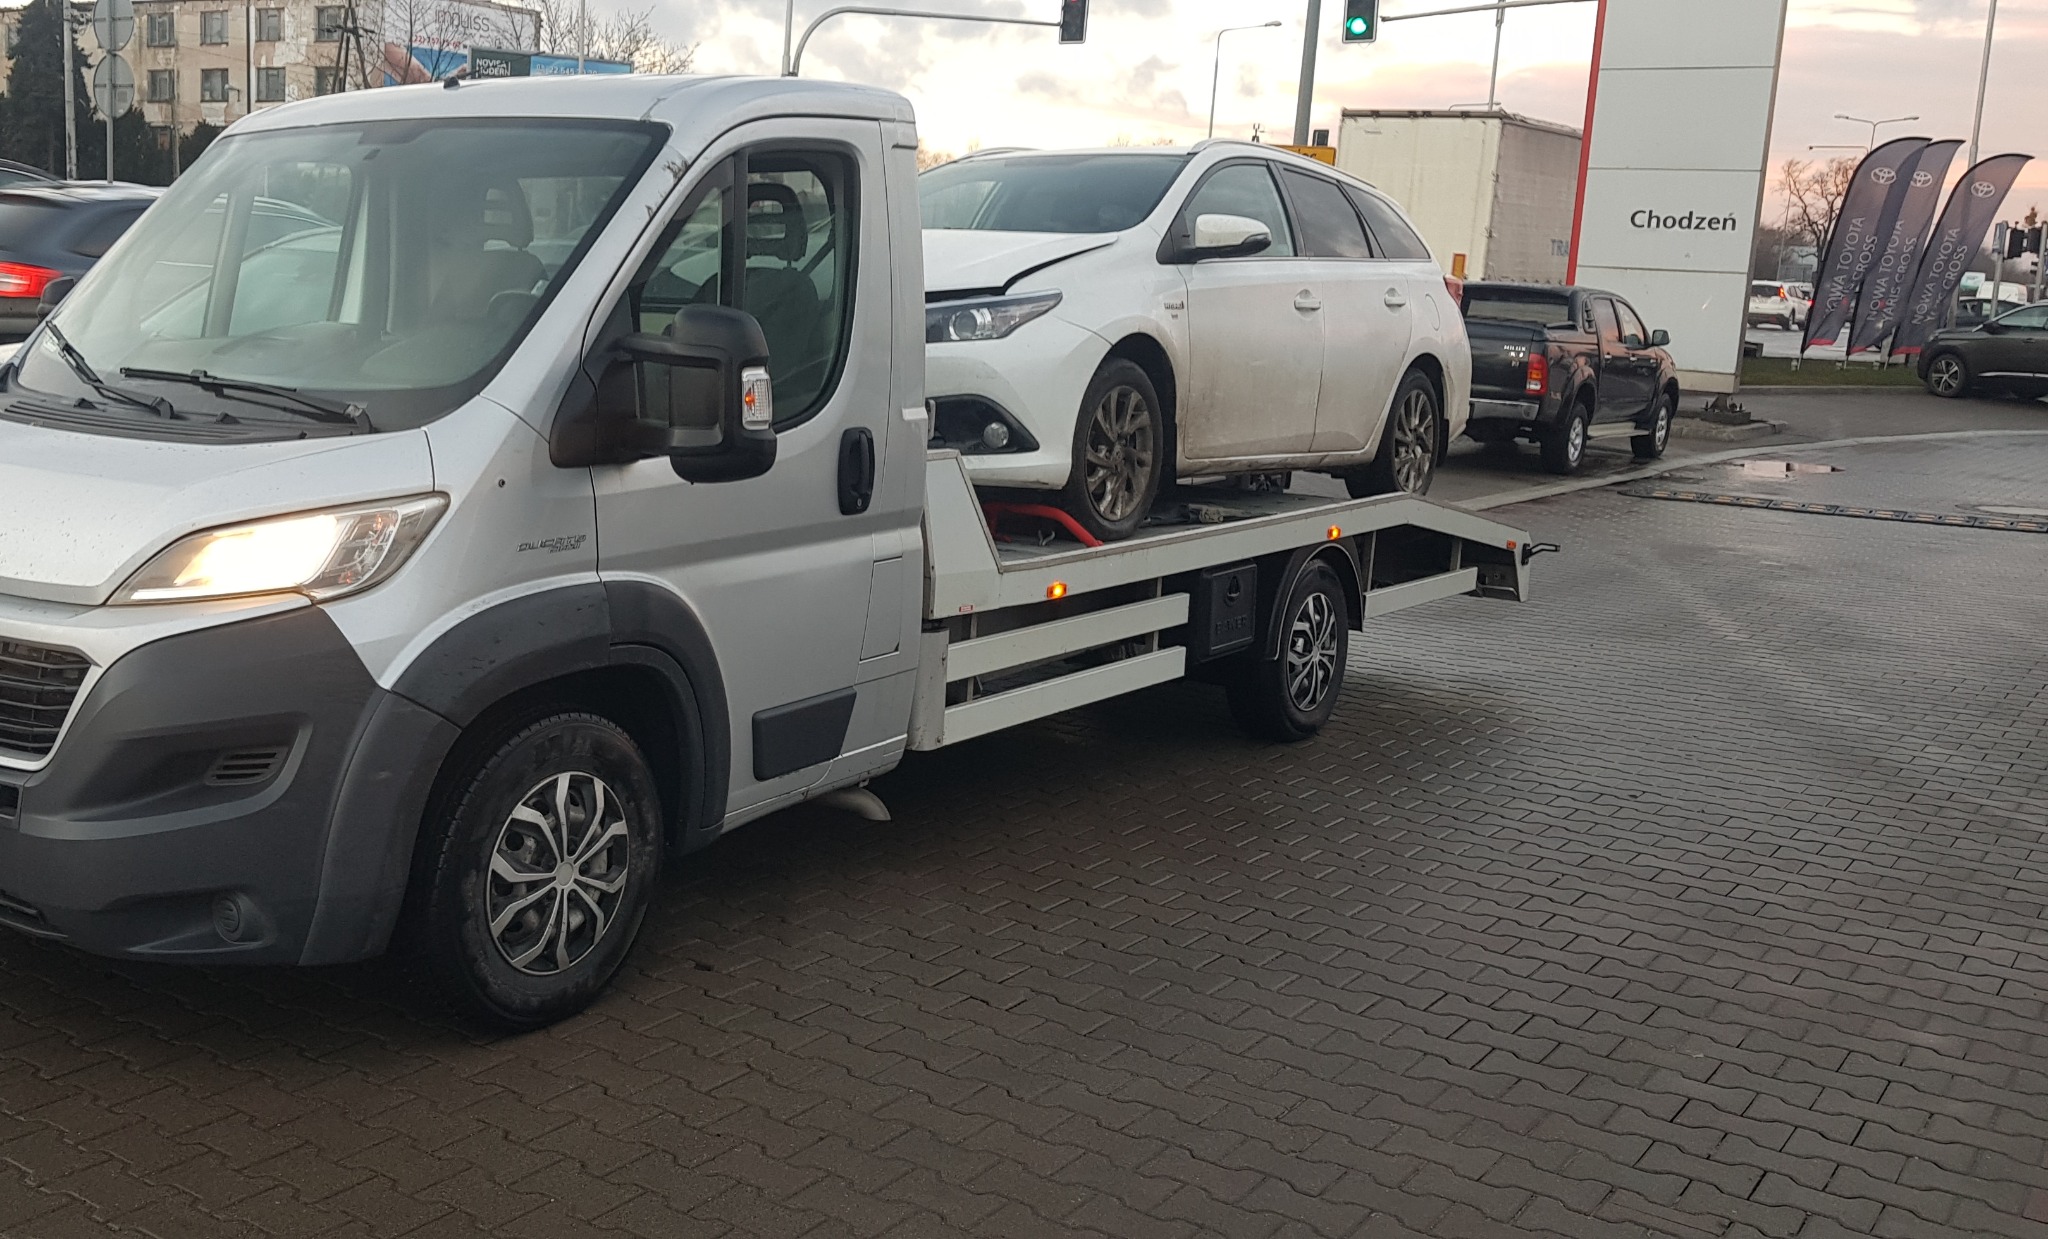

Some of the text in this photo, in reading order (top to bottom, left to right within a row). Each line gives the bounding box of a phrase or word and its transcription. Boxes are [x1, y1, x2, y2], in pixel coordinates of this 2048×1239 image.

[1630, 209, 1737, 231] Chodzeń
[1836, 216, 1866, 271] TOYOTA
[1852, 234, 1878, 281] CROSS
[1895, 236, 1918, 284] CROSS
[1911, 281, 1937, 326] NOWA
[1928, 227, 1961, 279] TOYOTA
[1942, 244, 1969, 290] CROSS
[1867, 275, 1890, 322] NOWA
